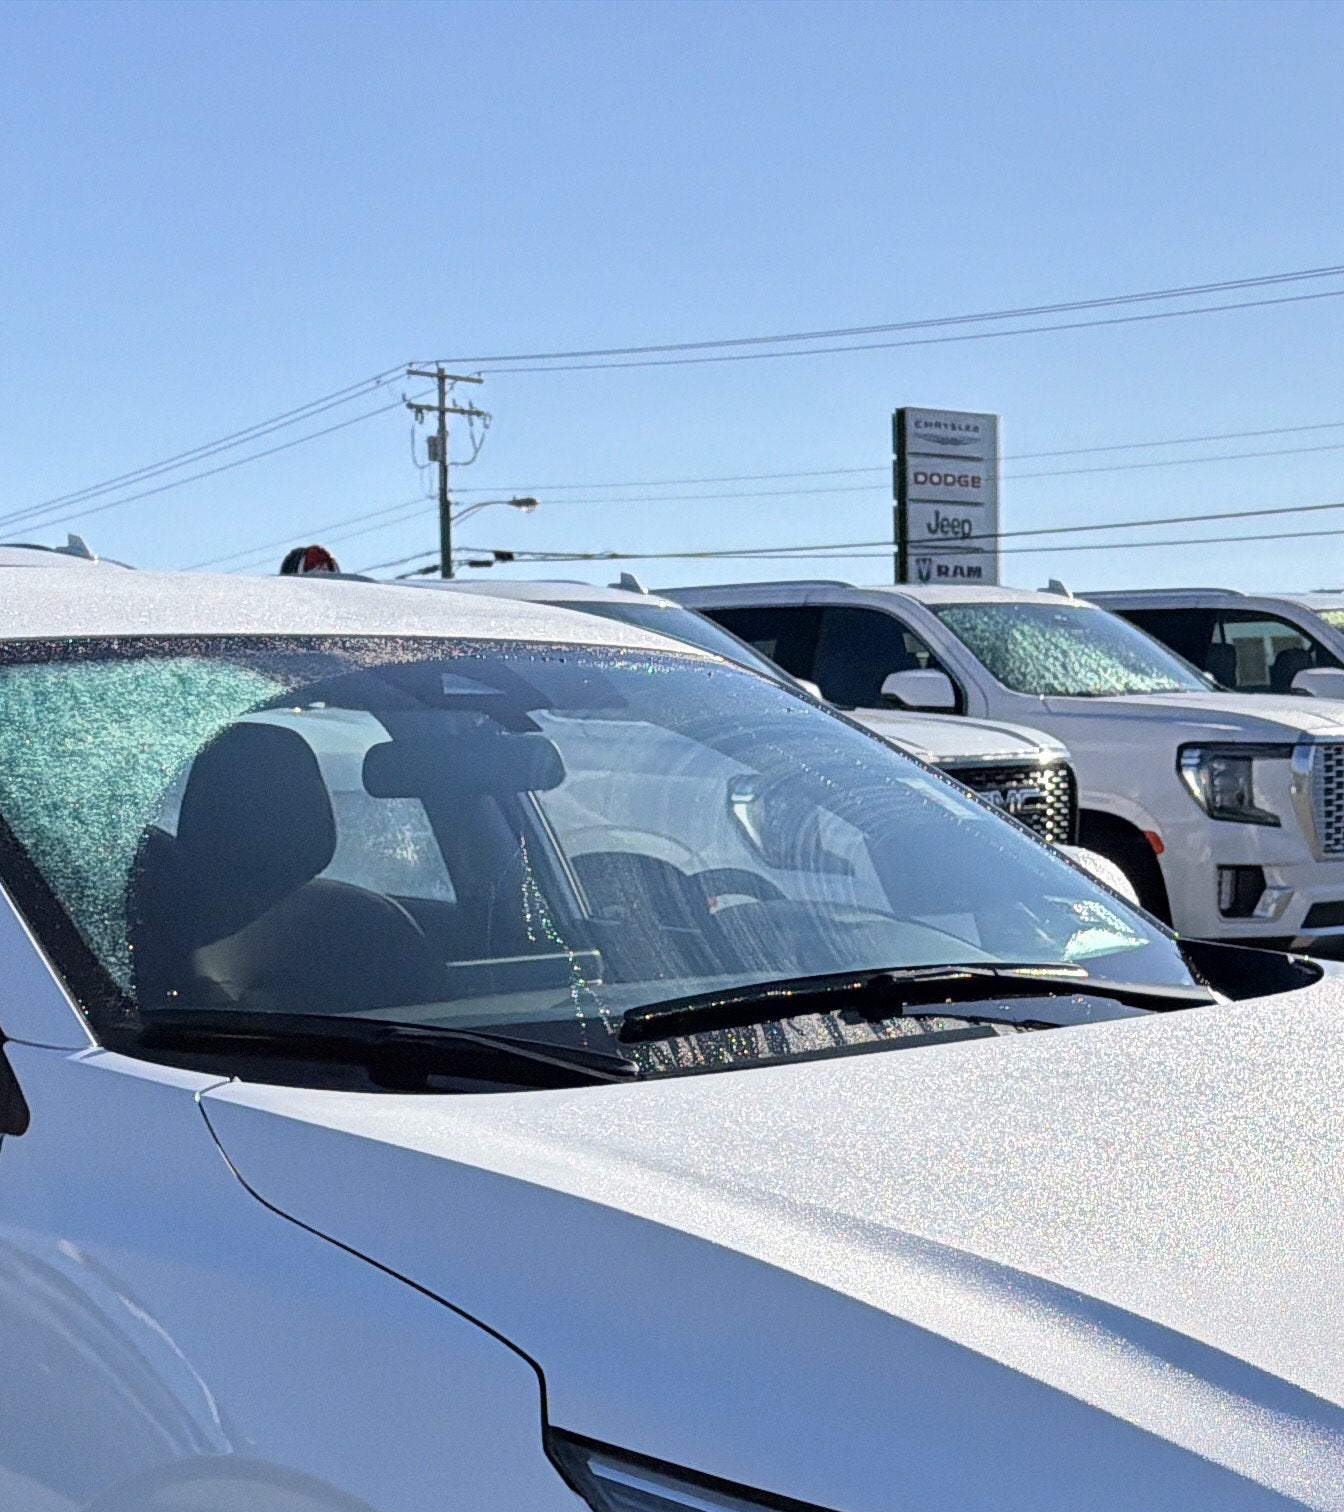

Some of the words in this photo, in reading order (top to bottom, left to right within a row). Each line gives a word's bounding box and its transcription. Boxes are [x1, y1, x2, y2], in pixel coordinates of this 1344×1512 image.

[914, 420, 980, 433] CHRYSLER
[913, 471, 982, 489] DODGE
[927, 510, 973, 540] Jeep
[936, 565, 983, 578] RAM
[979, 788, 1049, 813] MC
